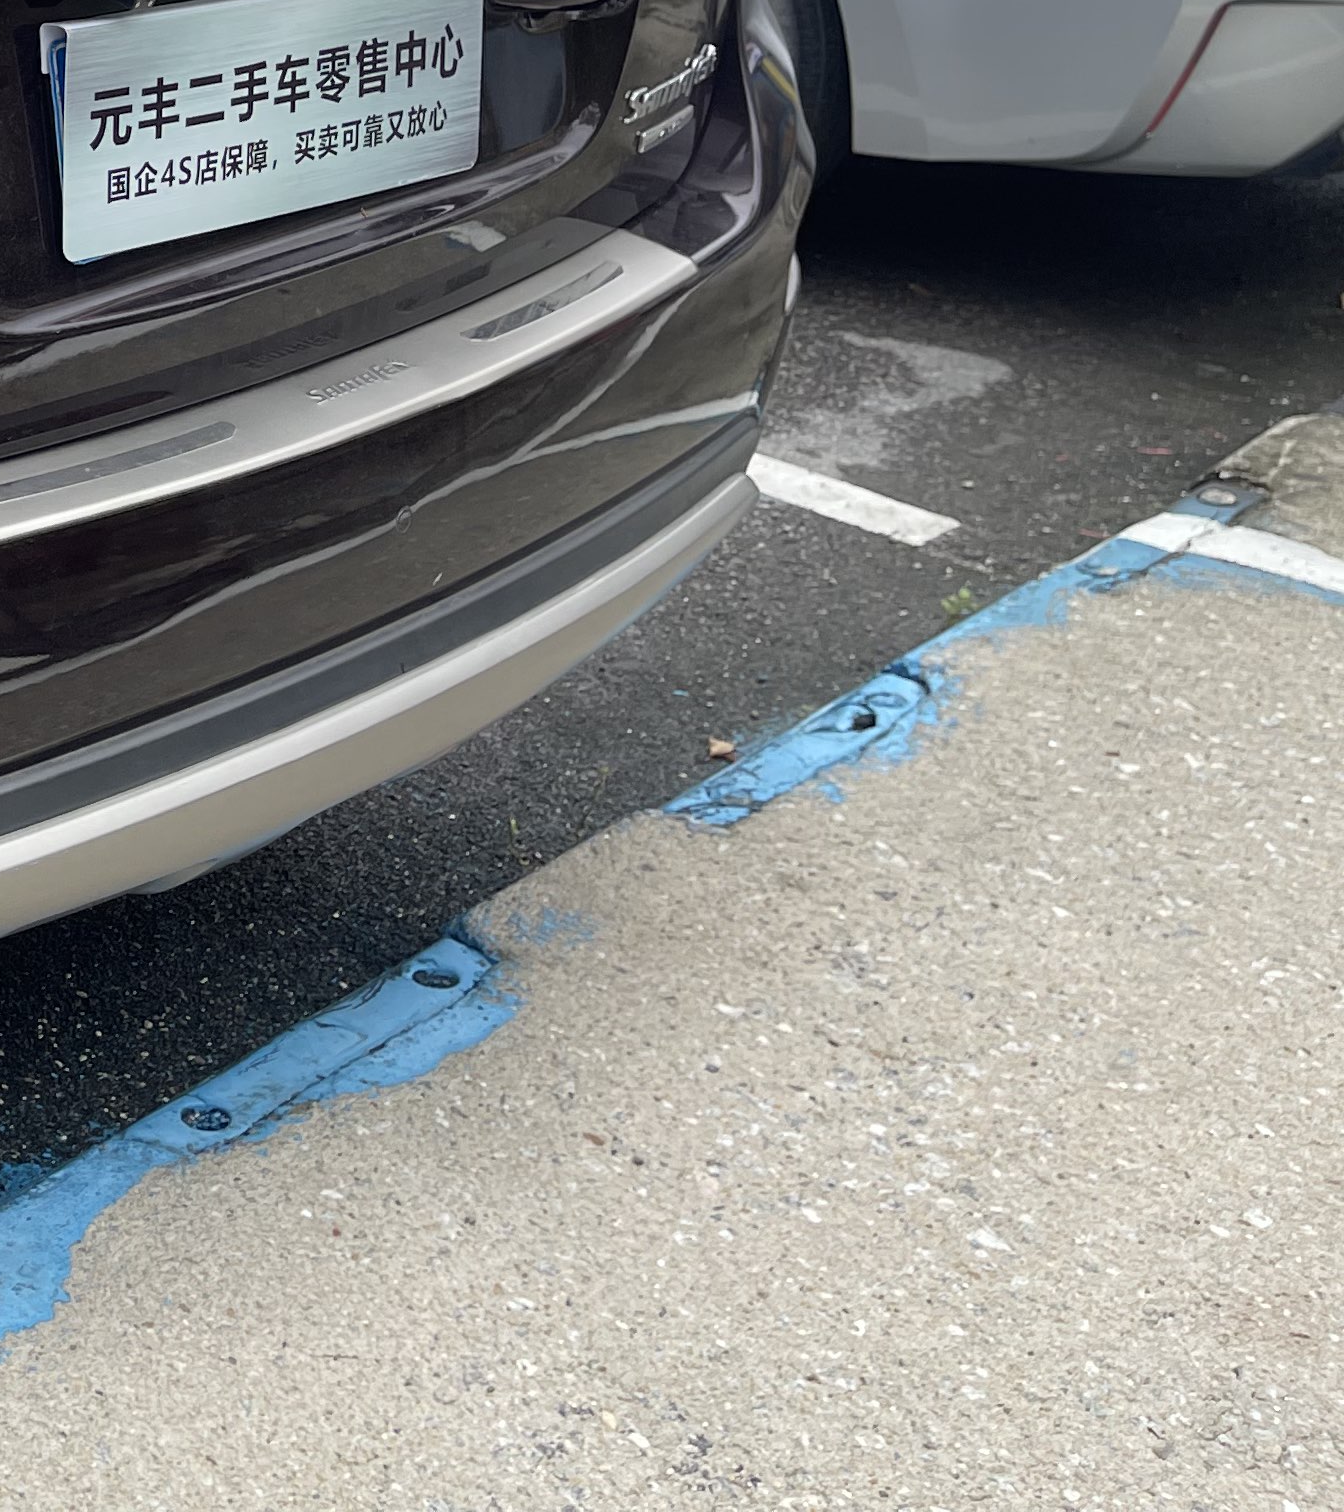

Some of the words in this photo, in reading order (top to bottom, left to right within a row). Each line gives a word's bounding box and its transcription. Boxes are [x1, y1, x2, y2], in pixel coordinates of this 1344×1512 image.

[89, 23, 465, 151] 元丰二手车零售中心
